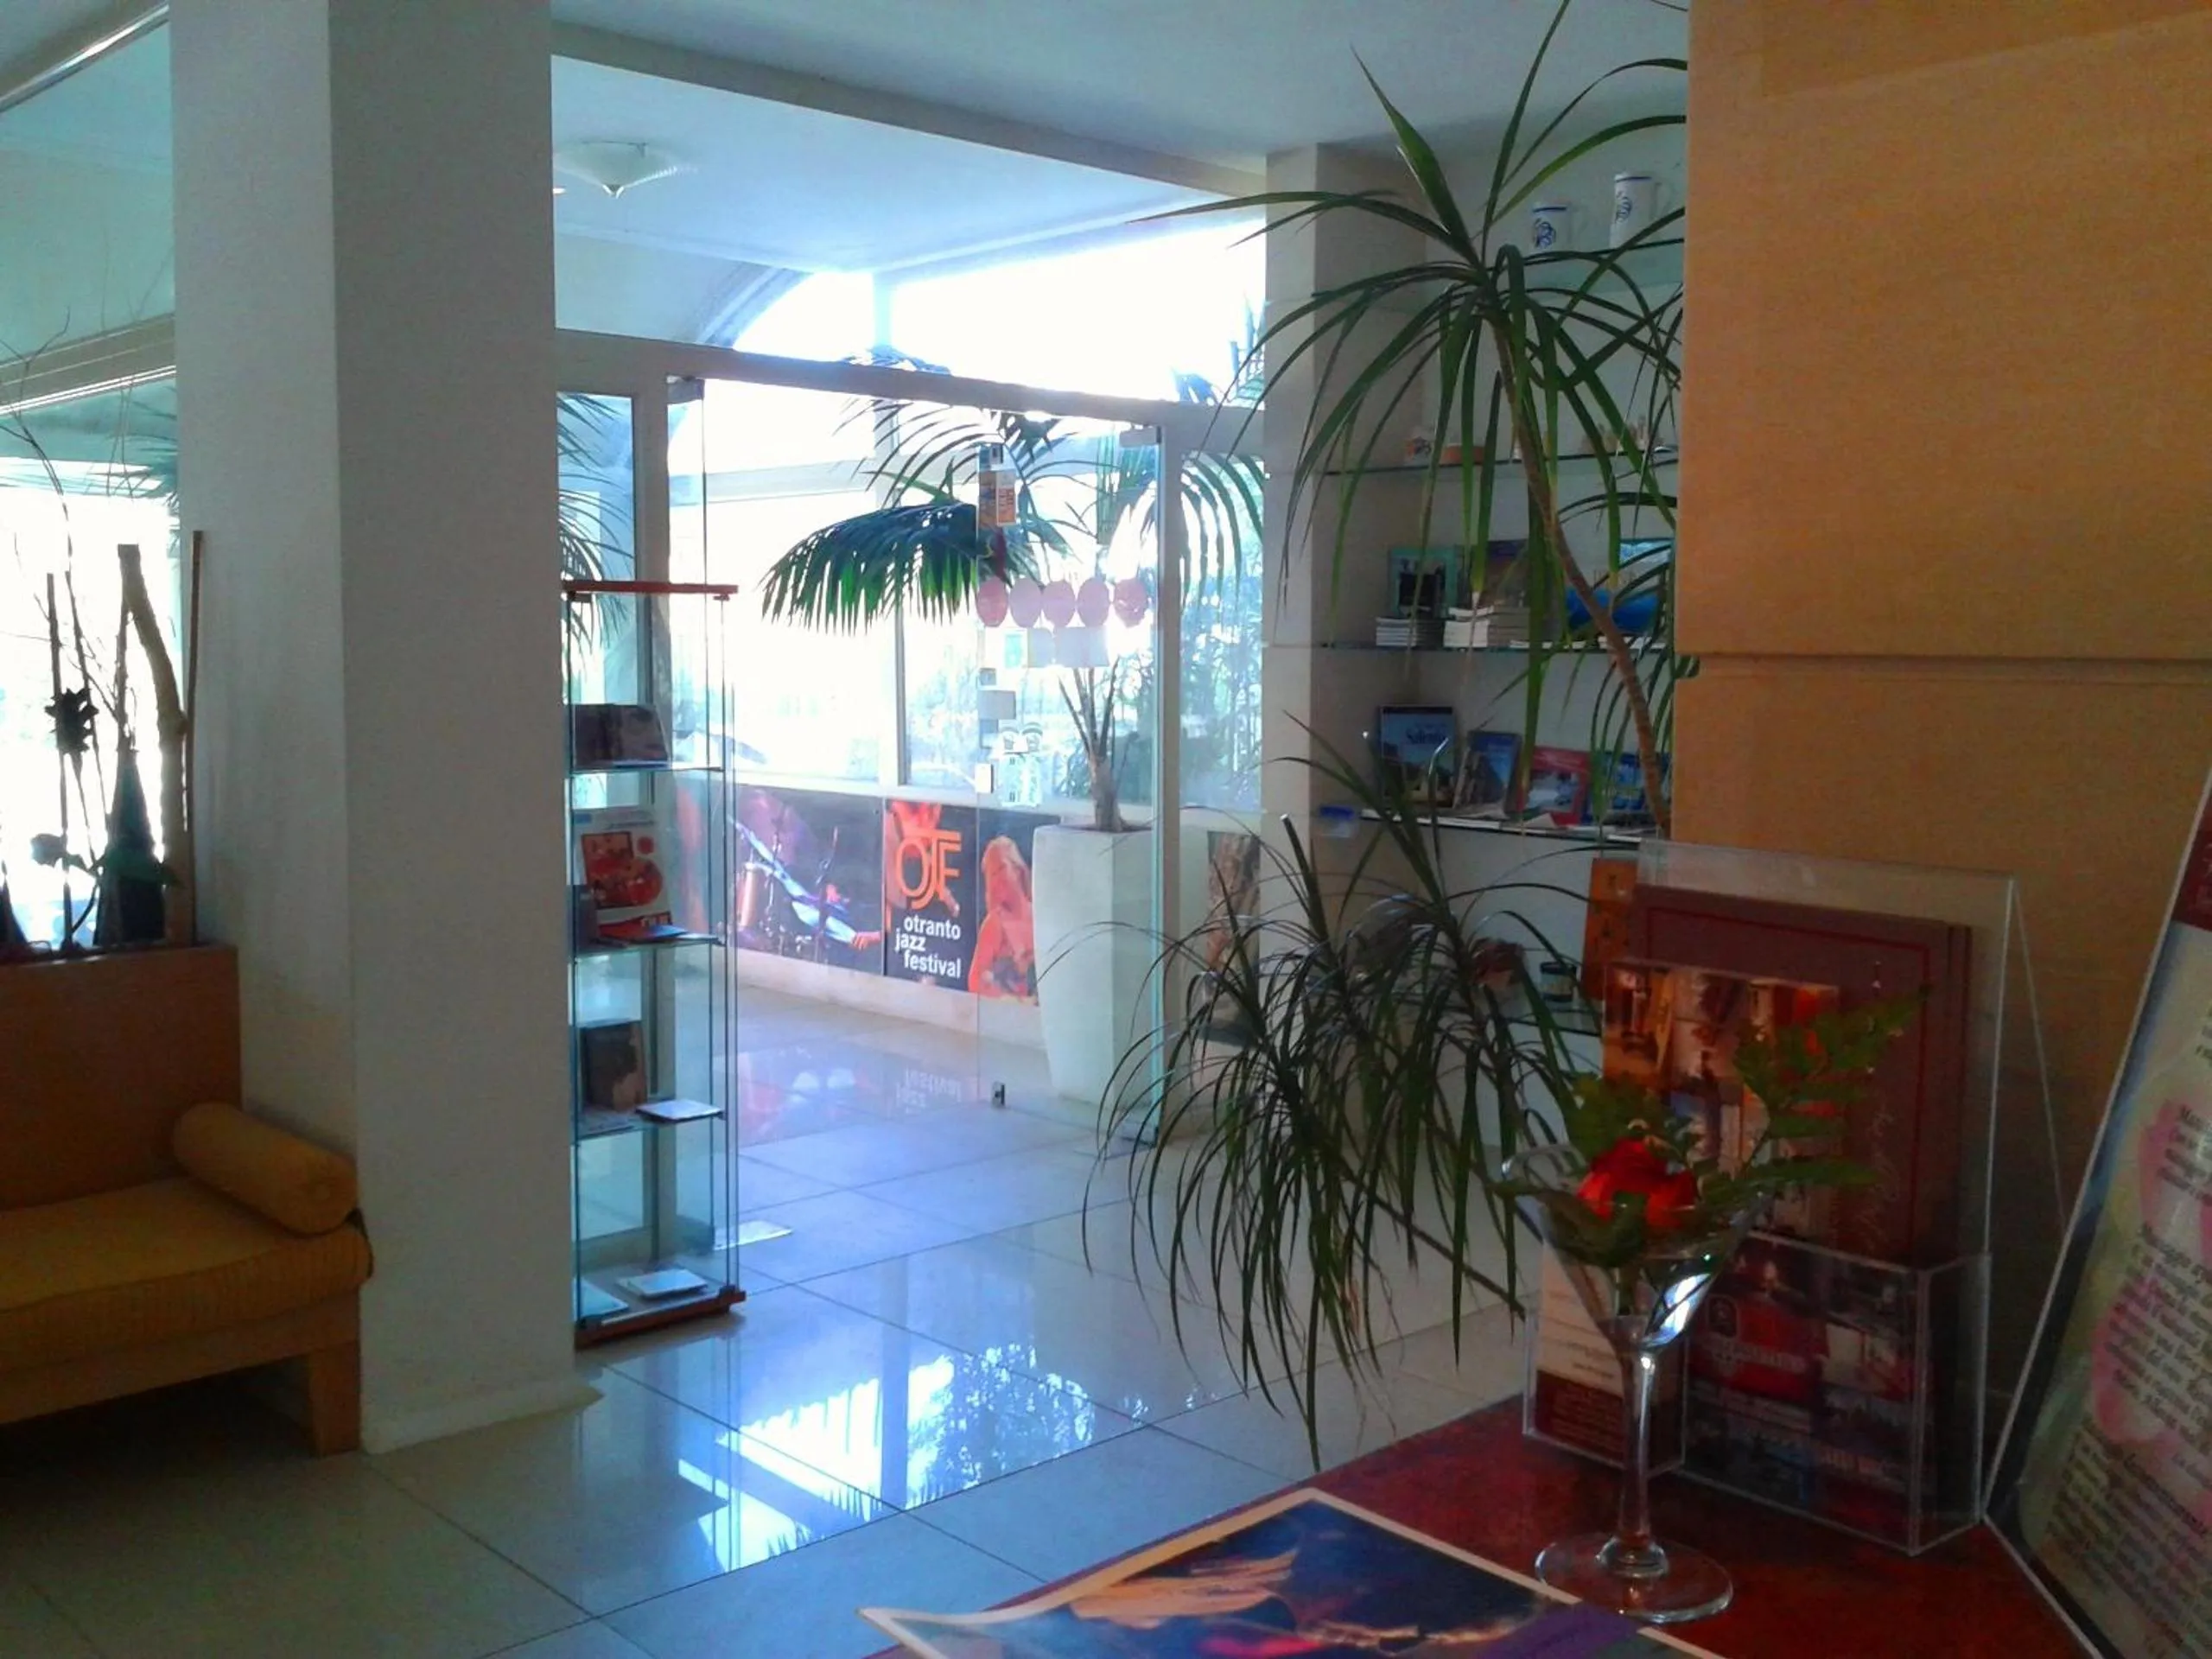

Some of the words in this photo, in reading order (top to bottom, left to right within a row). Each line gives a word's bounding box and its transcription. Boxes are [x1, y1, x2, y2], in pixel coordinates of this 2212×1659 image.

[904, 915, 961, 940] otranto
[895, 928, 926, 953] jazz
[904, 950, 961, 979] festival
